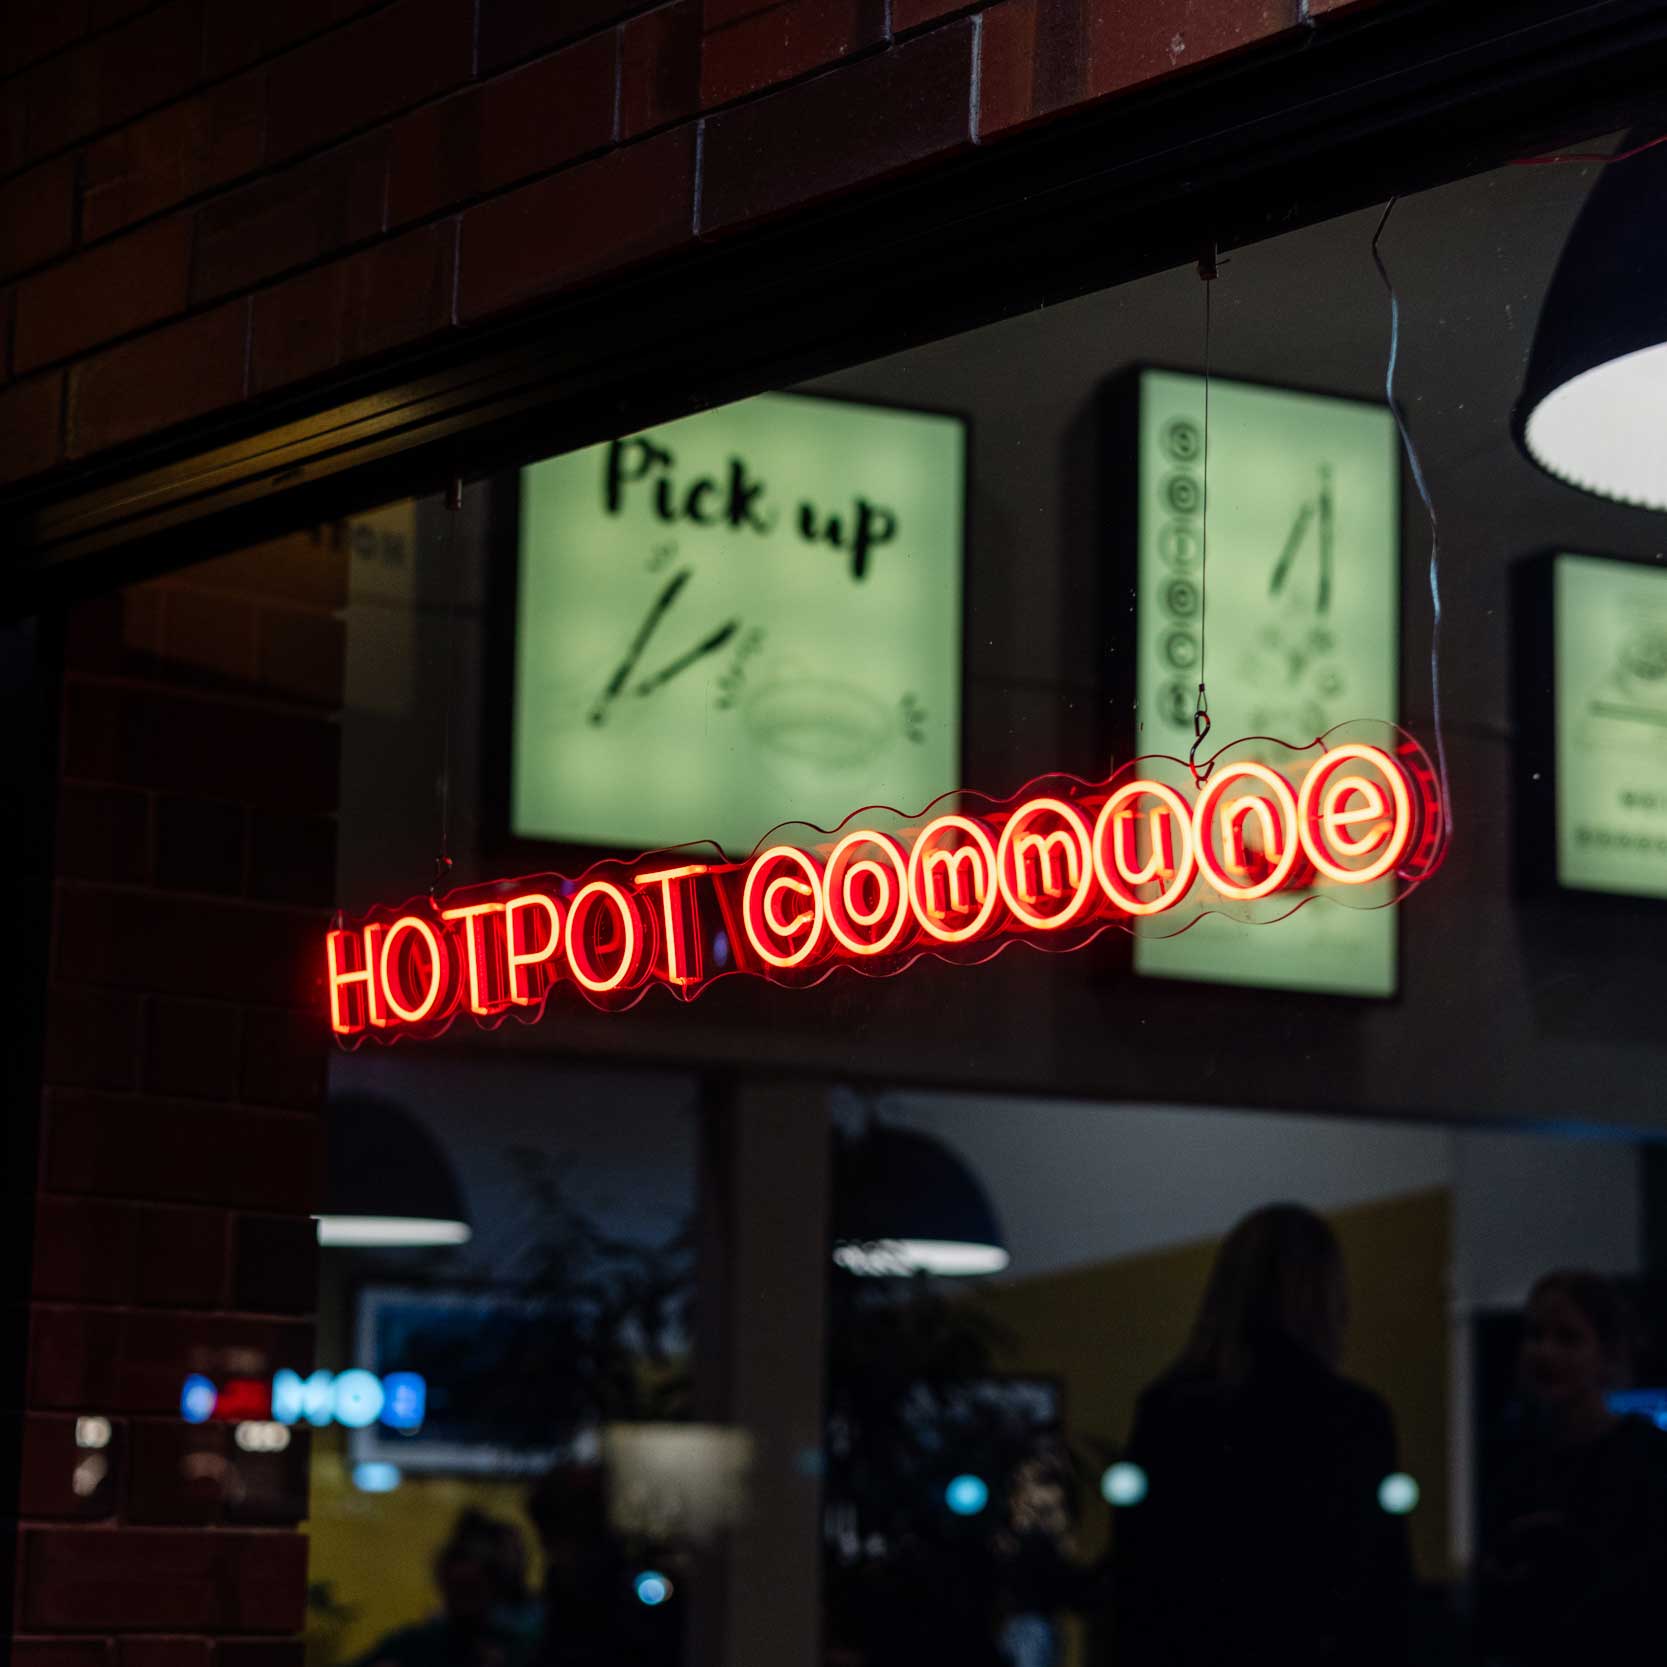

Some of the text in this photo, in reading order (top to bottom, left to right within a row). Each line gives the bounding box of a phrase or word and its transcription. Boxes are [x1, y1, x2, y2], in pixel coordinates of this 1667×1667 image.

[606, 437, 897, 580] Pick up
[326, 743, 1410, 1034] HOTPOT commune
